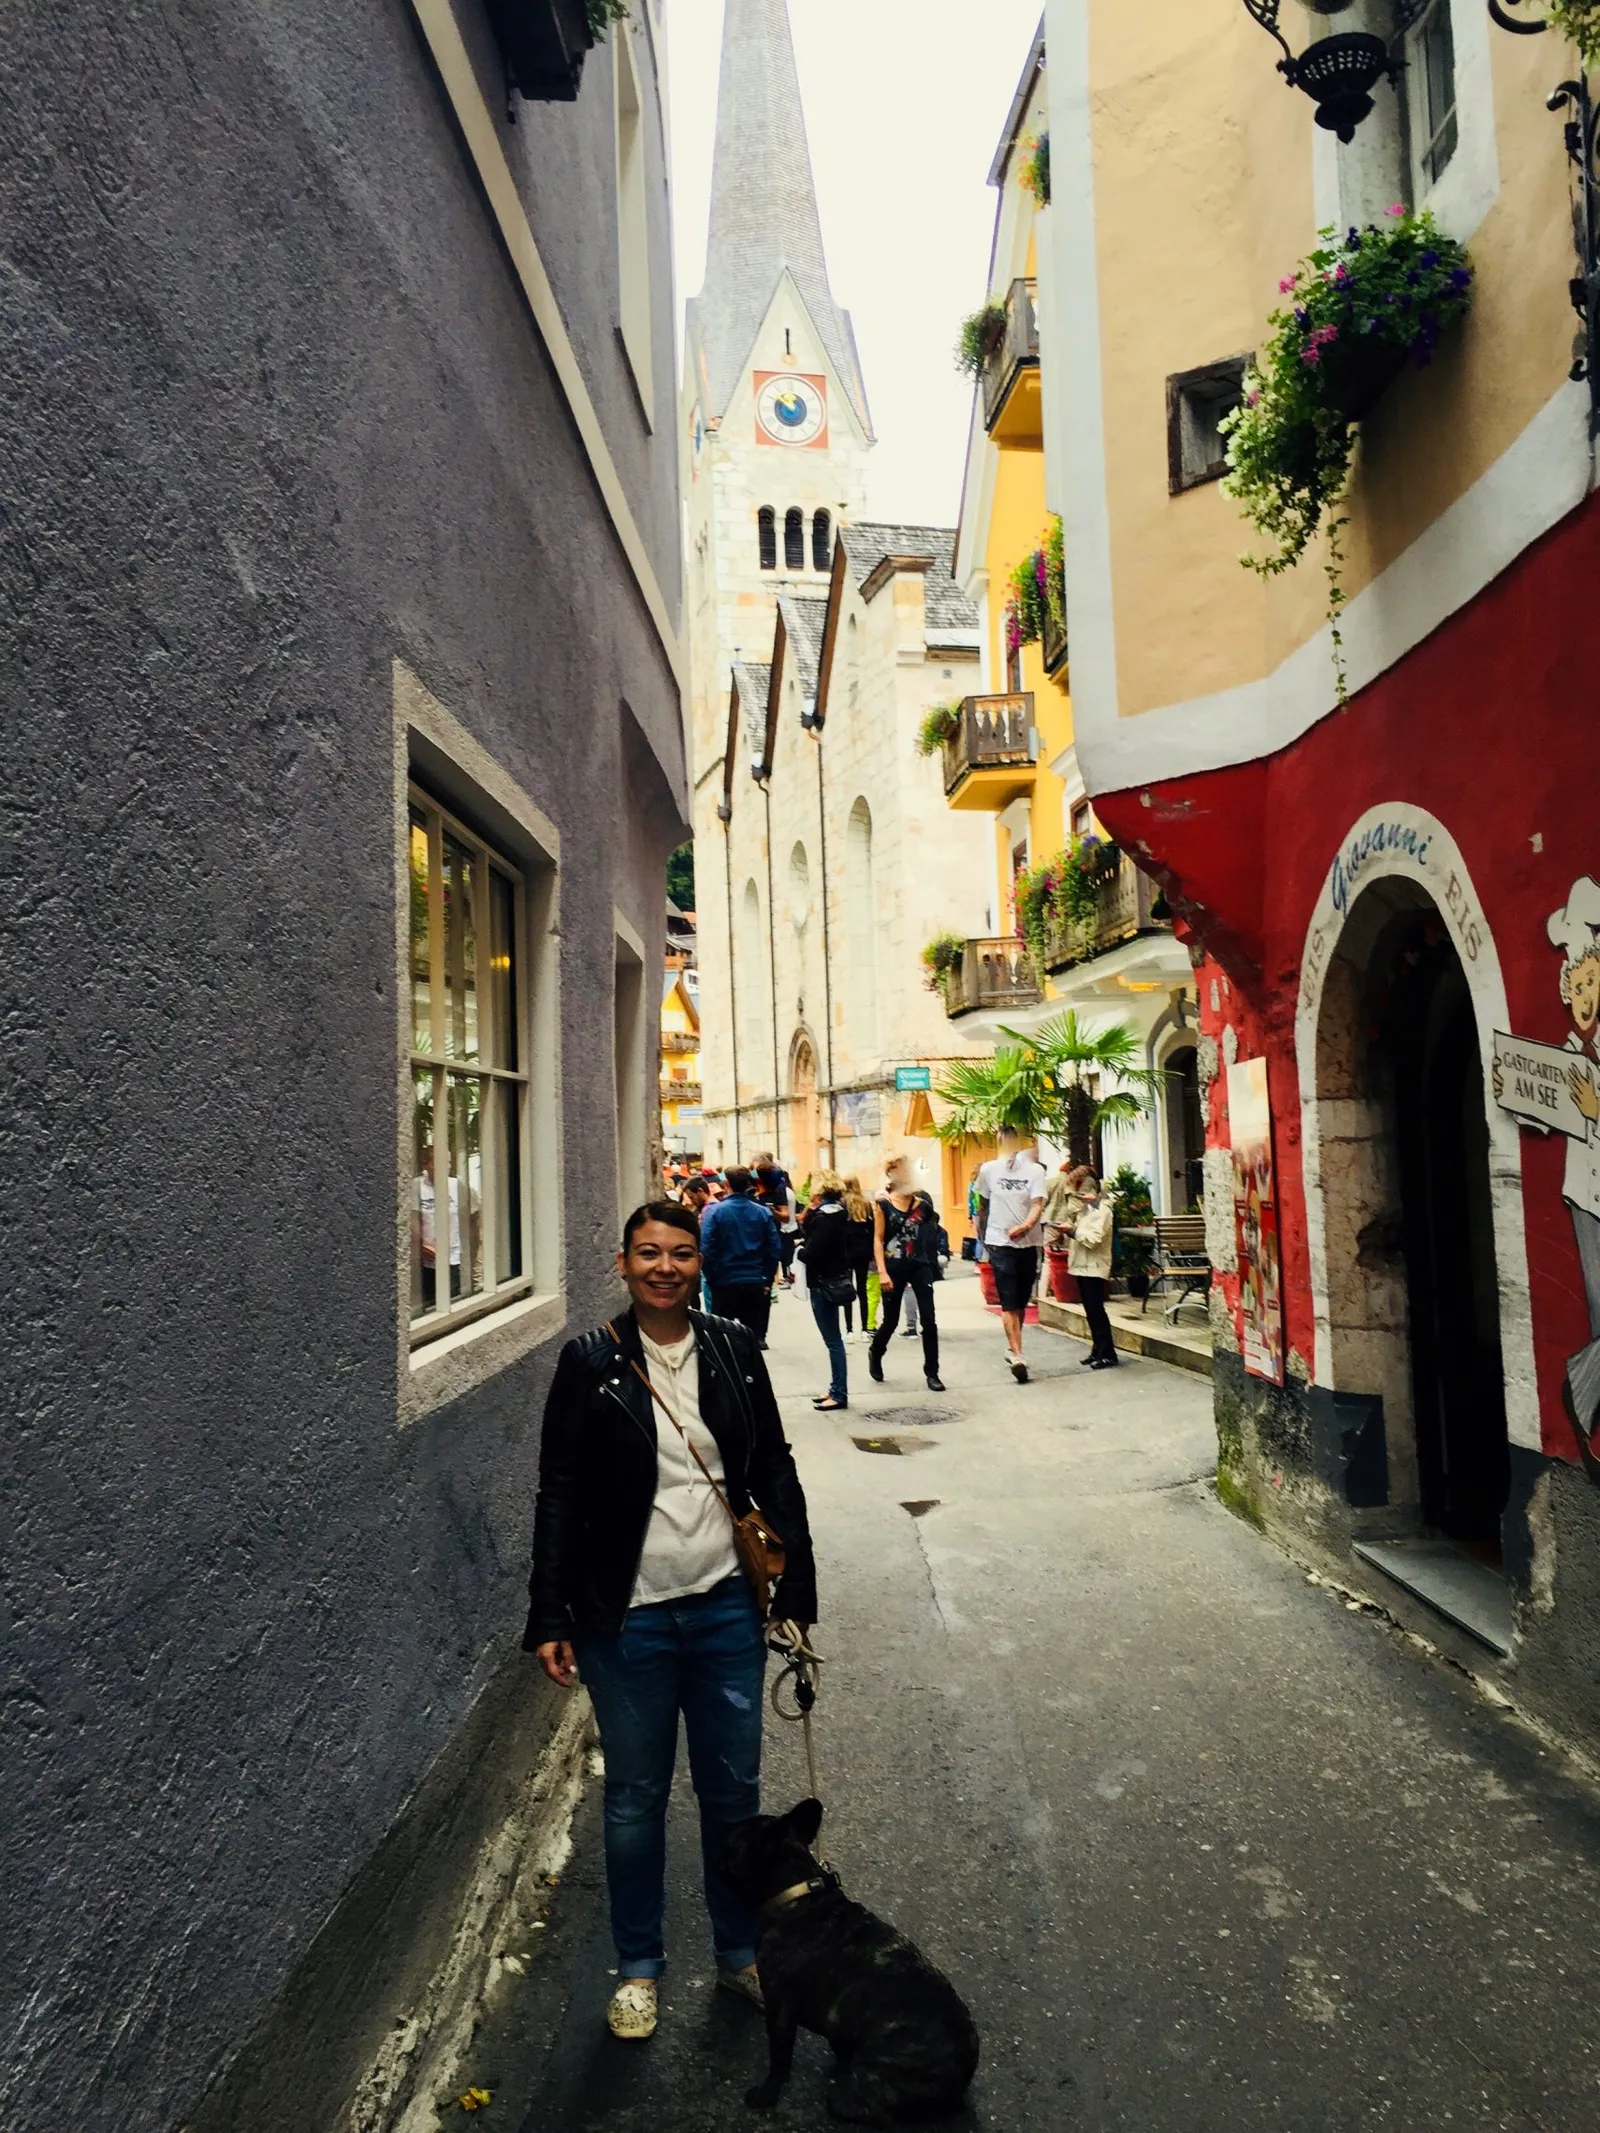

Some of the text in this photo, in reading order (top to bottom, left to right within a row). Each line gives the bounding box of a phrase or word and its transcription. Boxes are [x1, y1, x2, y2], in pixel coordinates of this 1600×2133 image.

[1332, 823, 1433, 920] Giovanni
[1445, 868, 1482, 961] EIS
[1503, 1051, 1569, 1087] GASTGARTEN
[1514, 1076, 1559, 1110] AM SEE
